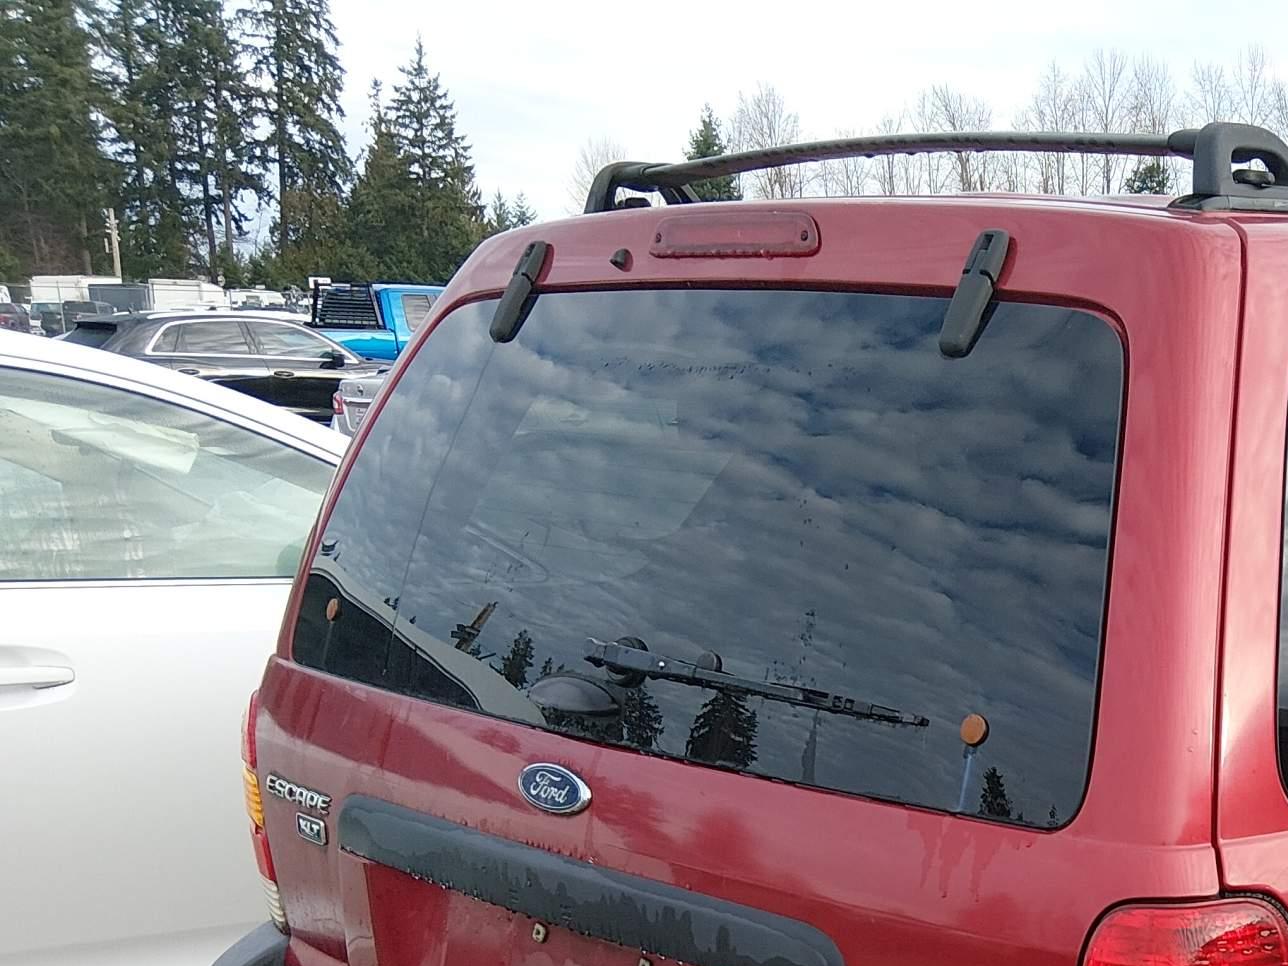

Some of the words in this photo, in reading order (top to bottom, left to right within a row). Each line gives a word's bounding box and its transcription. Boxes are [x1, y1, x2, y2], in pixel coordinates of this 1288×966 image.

[266, 774, 332, 815] ESCAPE
[530, 771, 570, 803] Ford
[299, 818, 320, 838] XLT
